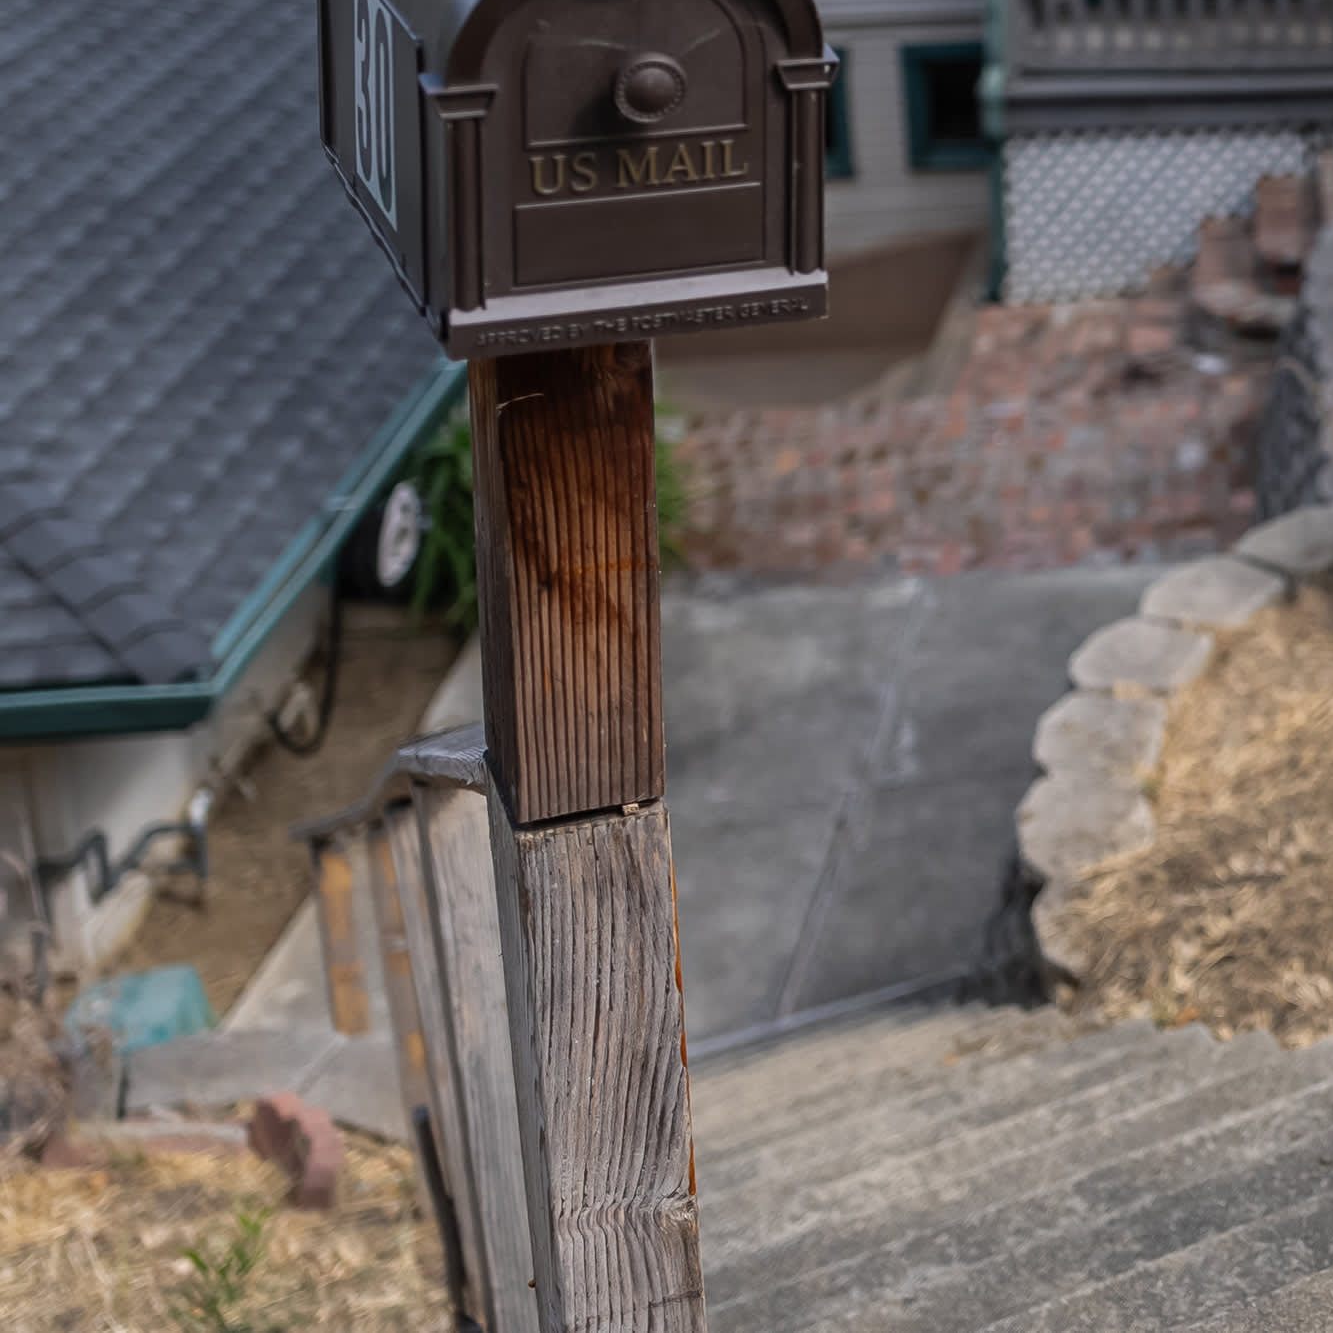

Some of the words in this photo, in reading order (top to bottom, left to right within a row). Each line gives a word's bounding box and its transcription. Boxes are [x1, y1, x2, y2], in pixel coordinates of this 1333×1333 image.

[529, 151, 599, 197] US
[615, 138, 750, 189] MAIL
[569, 321, 585, 339] BY
[594, 316, 627, 334] THE
[631, 304, 733, 331] POSTMASTER
[739, 297, 809, 318] GENERAL
